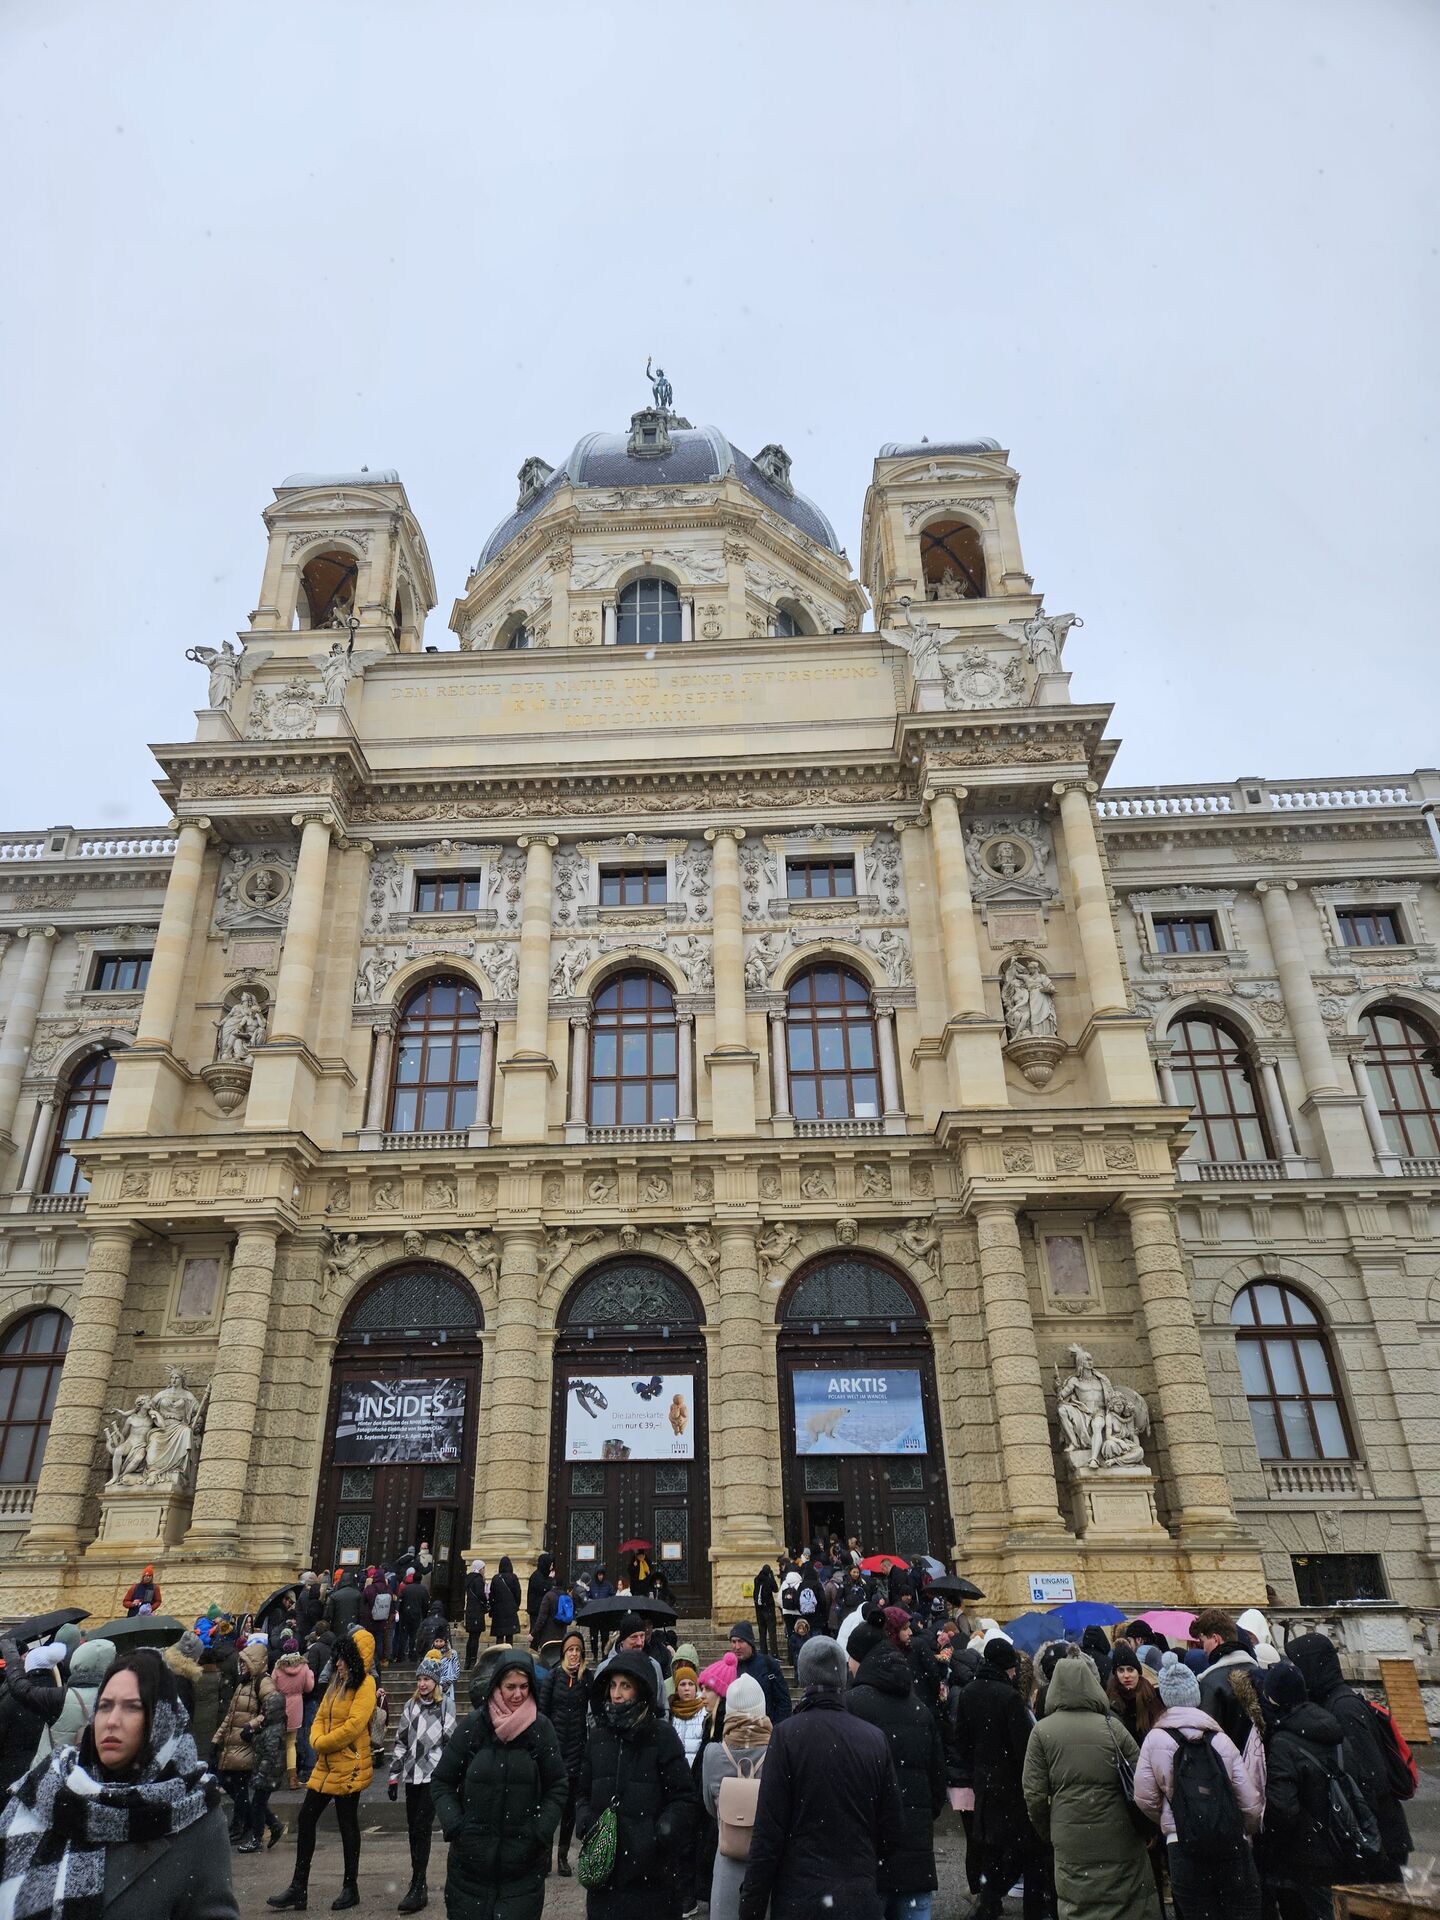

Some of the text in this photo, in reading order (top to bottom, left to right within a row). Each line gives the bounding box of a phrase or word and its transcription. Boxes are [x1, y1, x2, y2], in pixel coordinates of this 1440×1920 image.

[391, 666, 881, 699] DEM REICHE DER NATUR UND SEINER ERFORSCHUNG
[513, 697, 581, 712] KAISER
[592, 694, 650, 708] FRANZ
[660, 690, 735, 705] JOSEPH
[828, 1377, 888, 1393] ARKTIS
[359, 1395, 445, 1418] INSIDES
[611, 1411, 664, 1420] Die Jahreskarte
[638, 1422, 644, 1430] €
[671, 1440, 688, 1454] nhm
[115, 1517, 150, 1528] EUROPA
[1041, 1577, 1070, 1585] EINGANG
